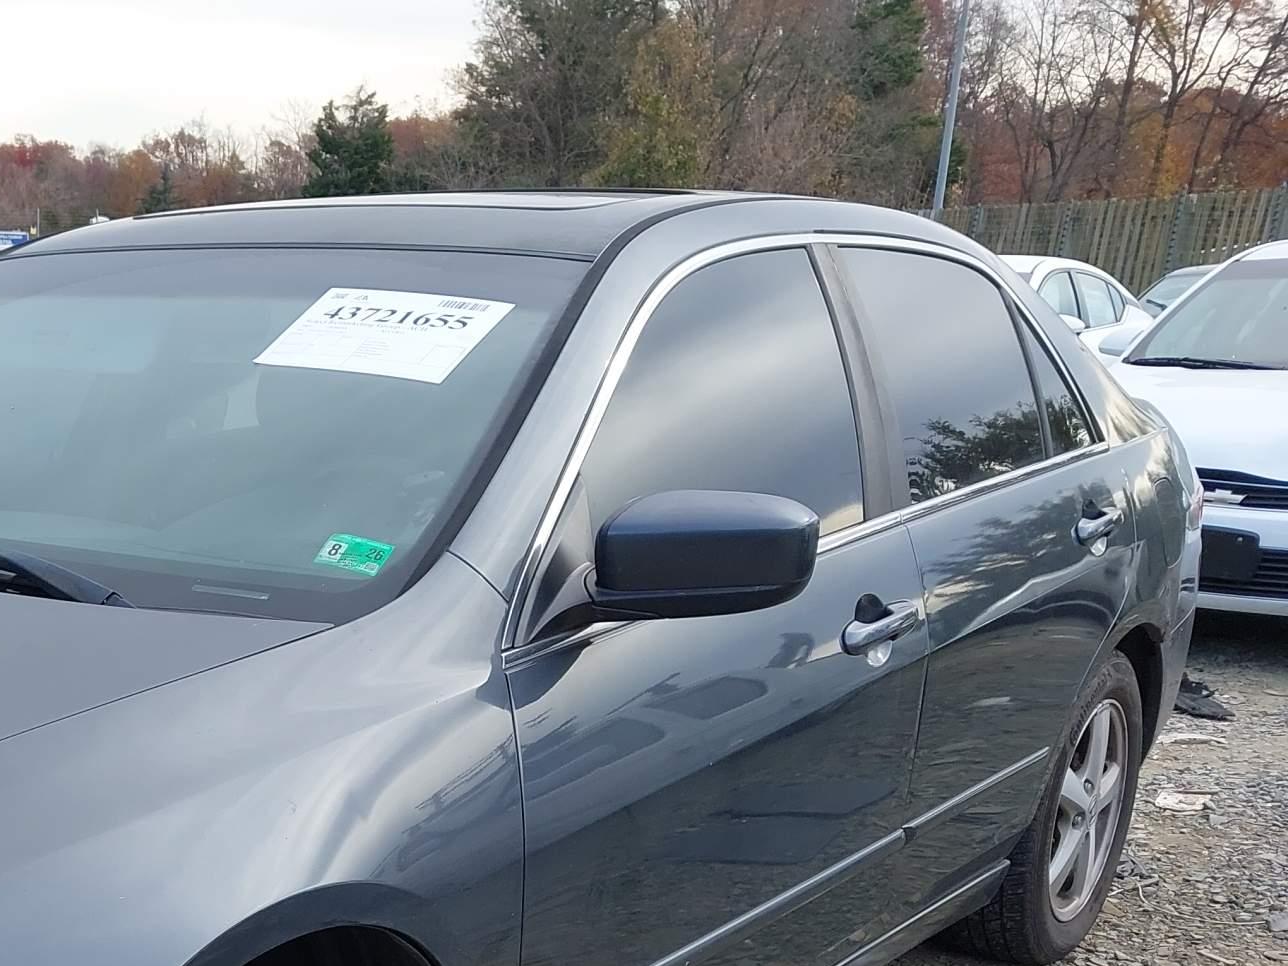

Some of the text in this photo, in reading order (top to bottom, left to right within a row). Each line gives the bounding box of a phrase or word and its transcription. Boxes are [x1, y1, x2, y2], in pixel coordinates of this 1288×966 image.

[323, 306, 474, 330] 43721655
[328, 543, 342, 557] 8
[365, 548, 385, 561] 26
